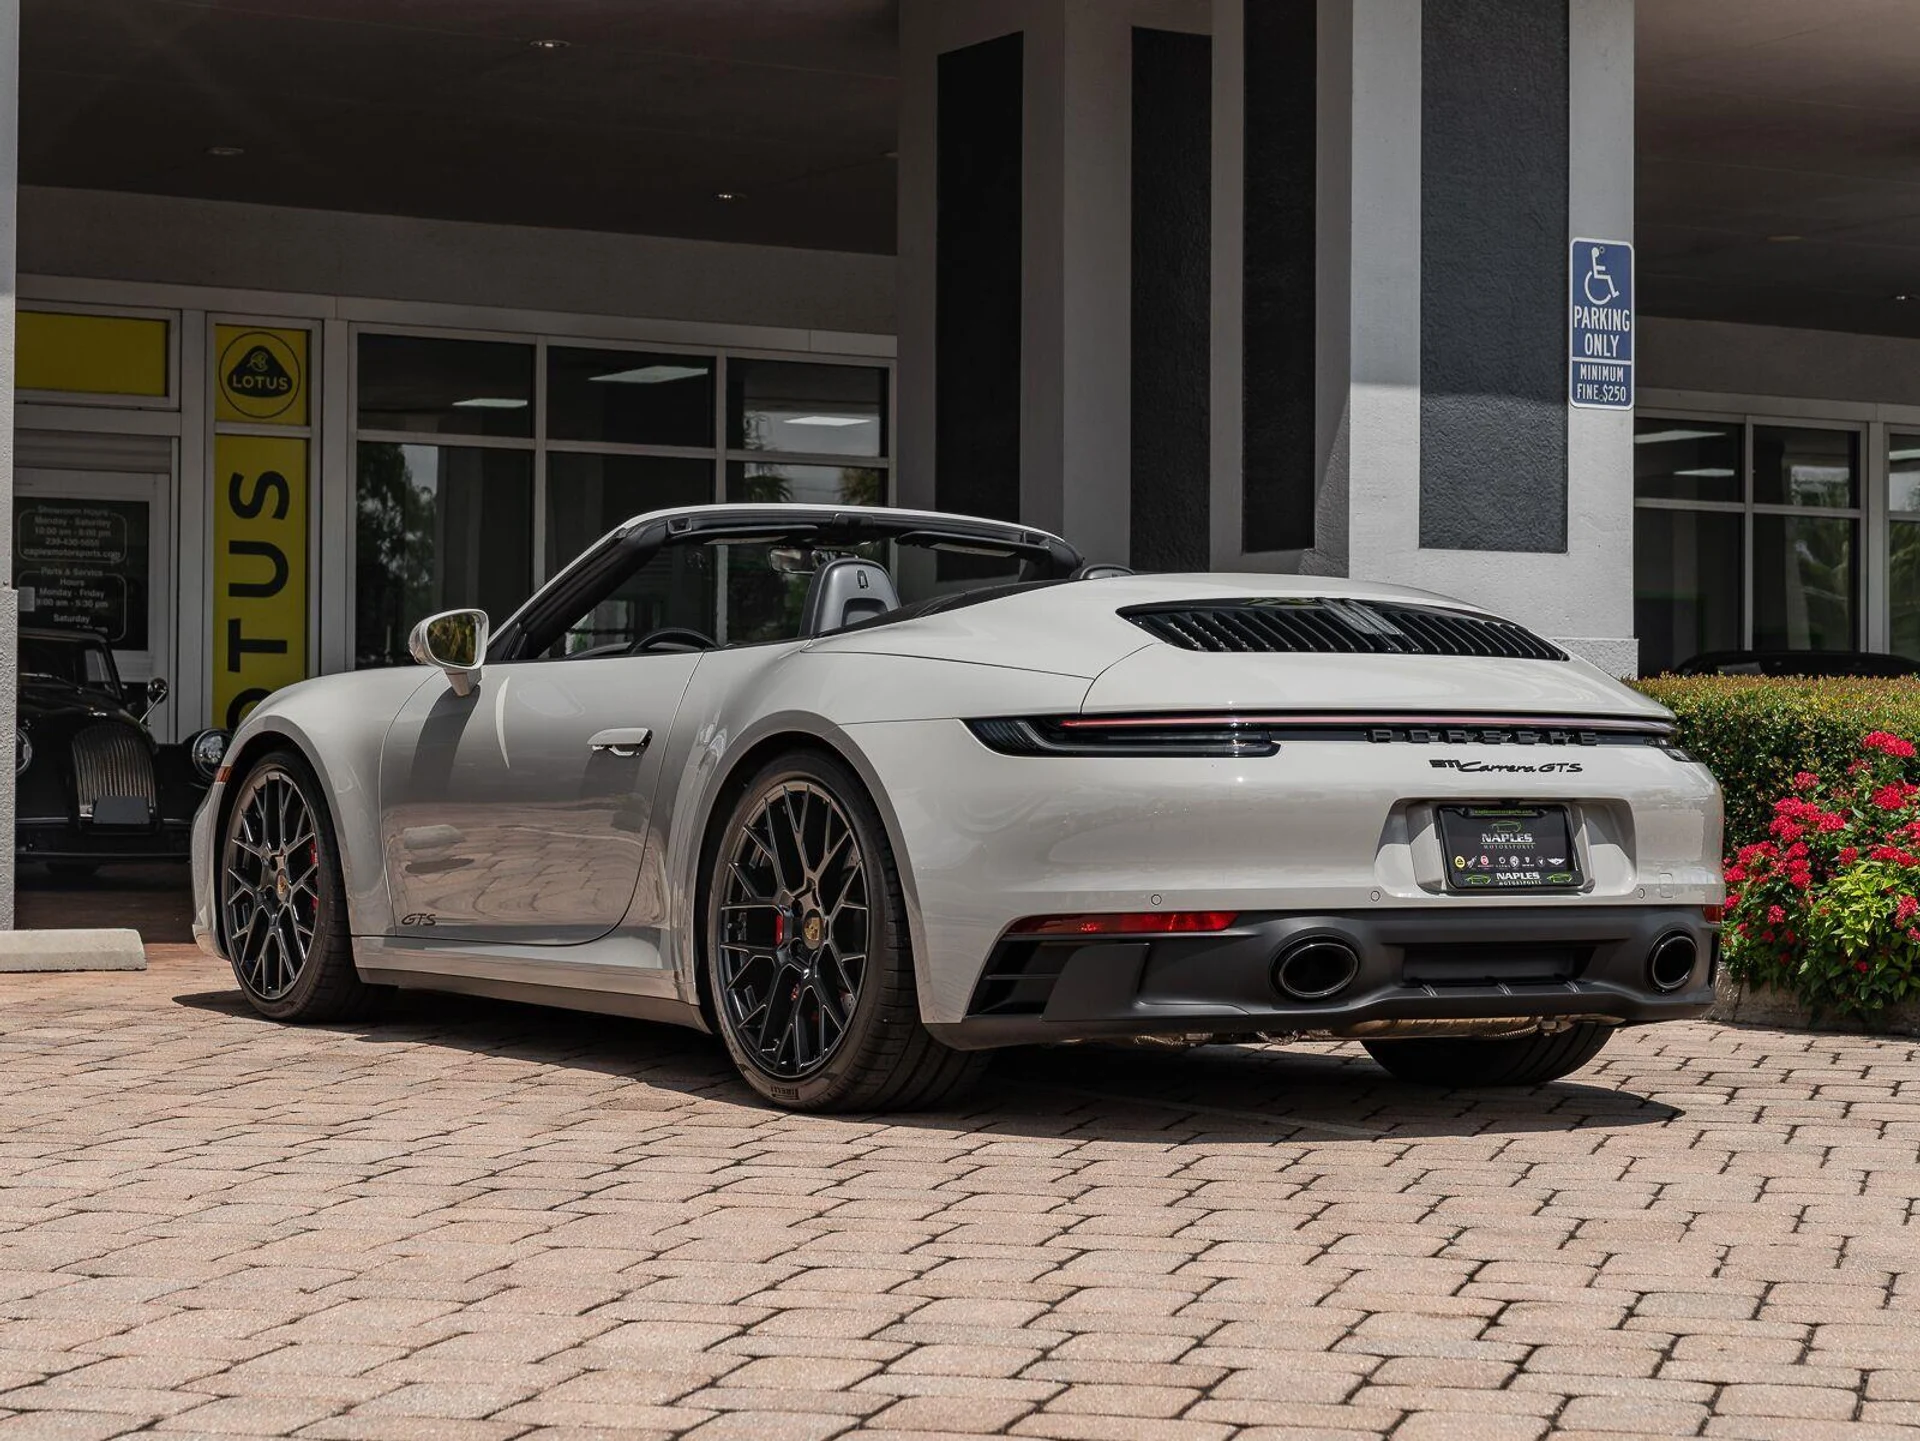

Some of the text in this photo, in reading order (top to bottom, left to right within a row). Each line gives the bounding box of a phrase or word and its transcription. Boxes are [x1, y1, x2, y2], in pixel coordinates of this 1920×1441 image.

[1574, 305, 1630, 332] PARKING
[1584, 333, 1620, 358] ONLY
[1580, 363, 1624, 382] MINIMUM
[232, 374, 289, 391] LOTUS
[1577, 383, 1626, 402] FINE $250
[40, 566, 63, 577] Parts
[73, 568, 103, 579] Service
[60, 577, 85, 587] Hours
[39, 587, 73, 598] Monday
[79, 588, 105, 600] Friday
[94, 601, 108, 610] pm
[53, 613, 90, 624] Saturday
[1366, 729, 1599, 746] PORSCHE
[1458, 761, 1536, 773] Carrera
[1538, 763, 1583, 773] GTS
[1481, 833, 1533, 843] NAPLES
[1496, 871, 1541, 880] NAPLES
[401, 913, 436, 926] GTS
